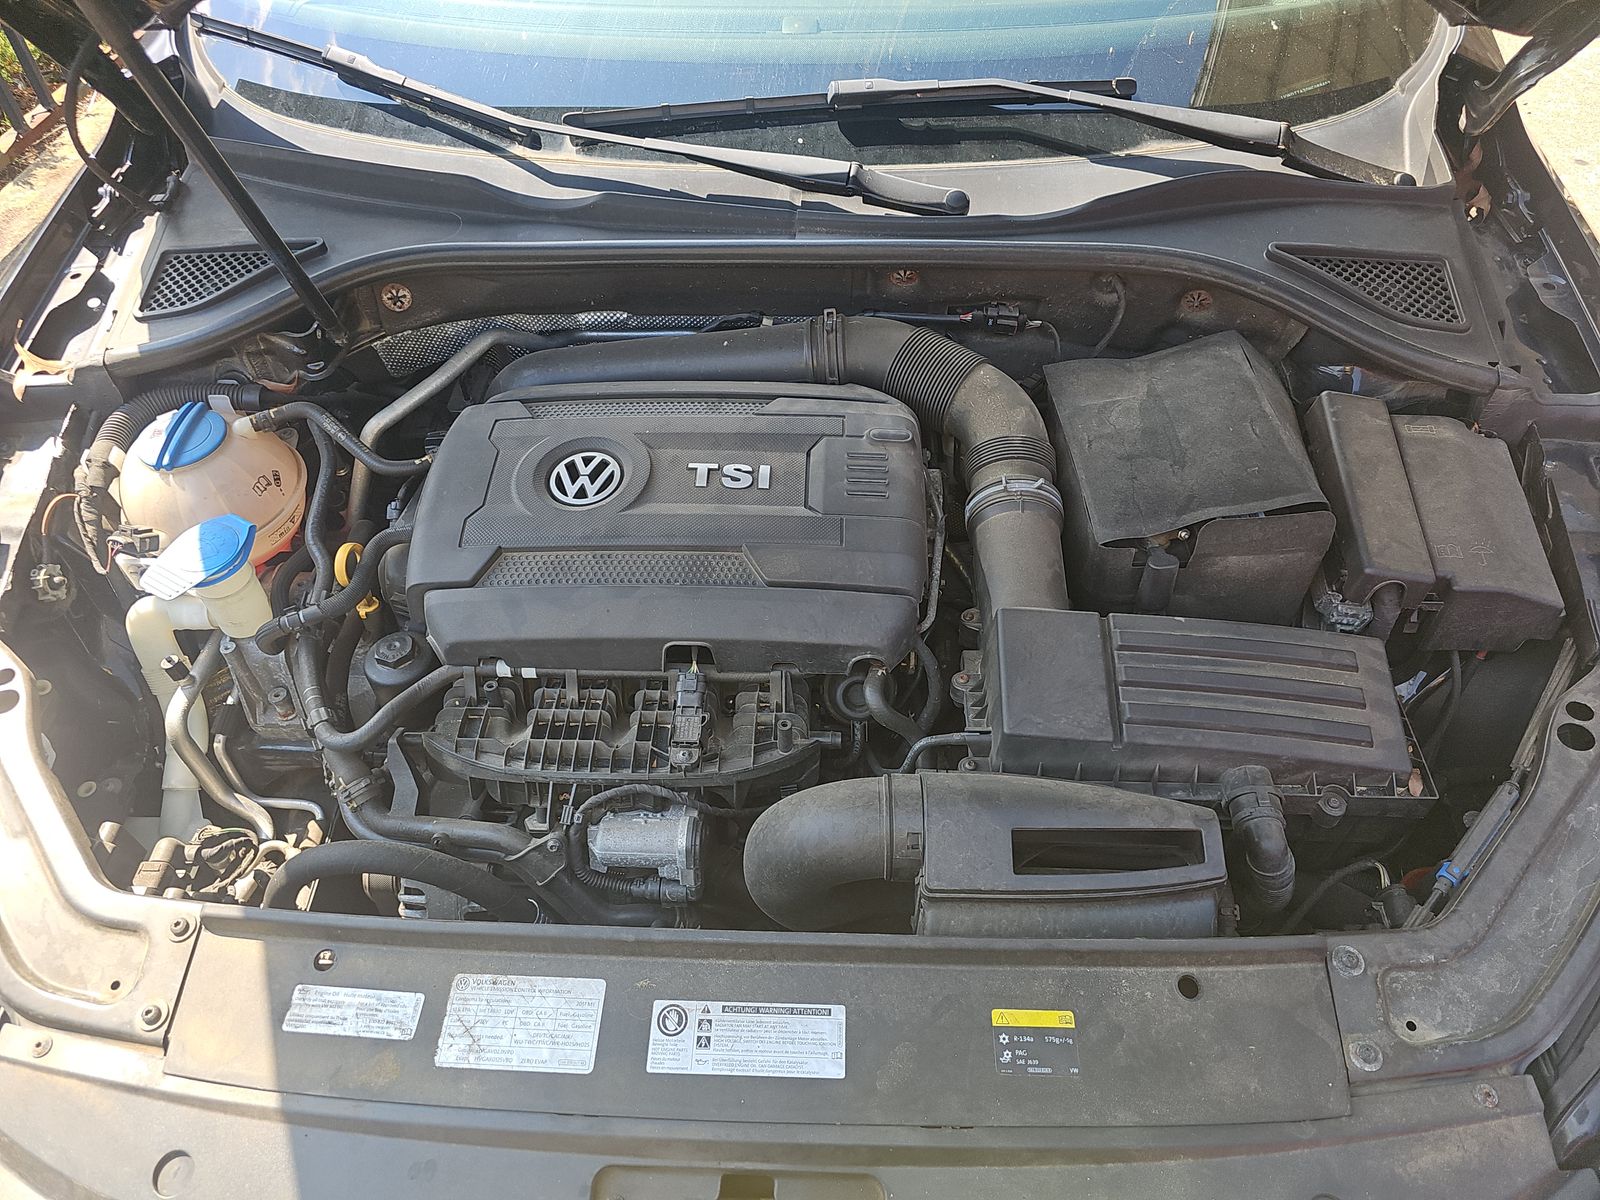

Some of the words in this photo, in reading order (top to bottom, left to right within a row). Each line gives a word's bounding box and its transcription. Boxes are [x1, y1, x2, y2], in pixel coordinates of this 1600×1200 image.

[688, 462, 771, 489] TSI
[472, 978, 516, 986] VOLKSWAGEN
[724, 1005, 758, 1013] ACHTUNG!
